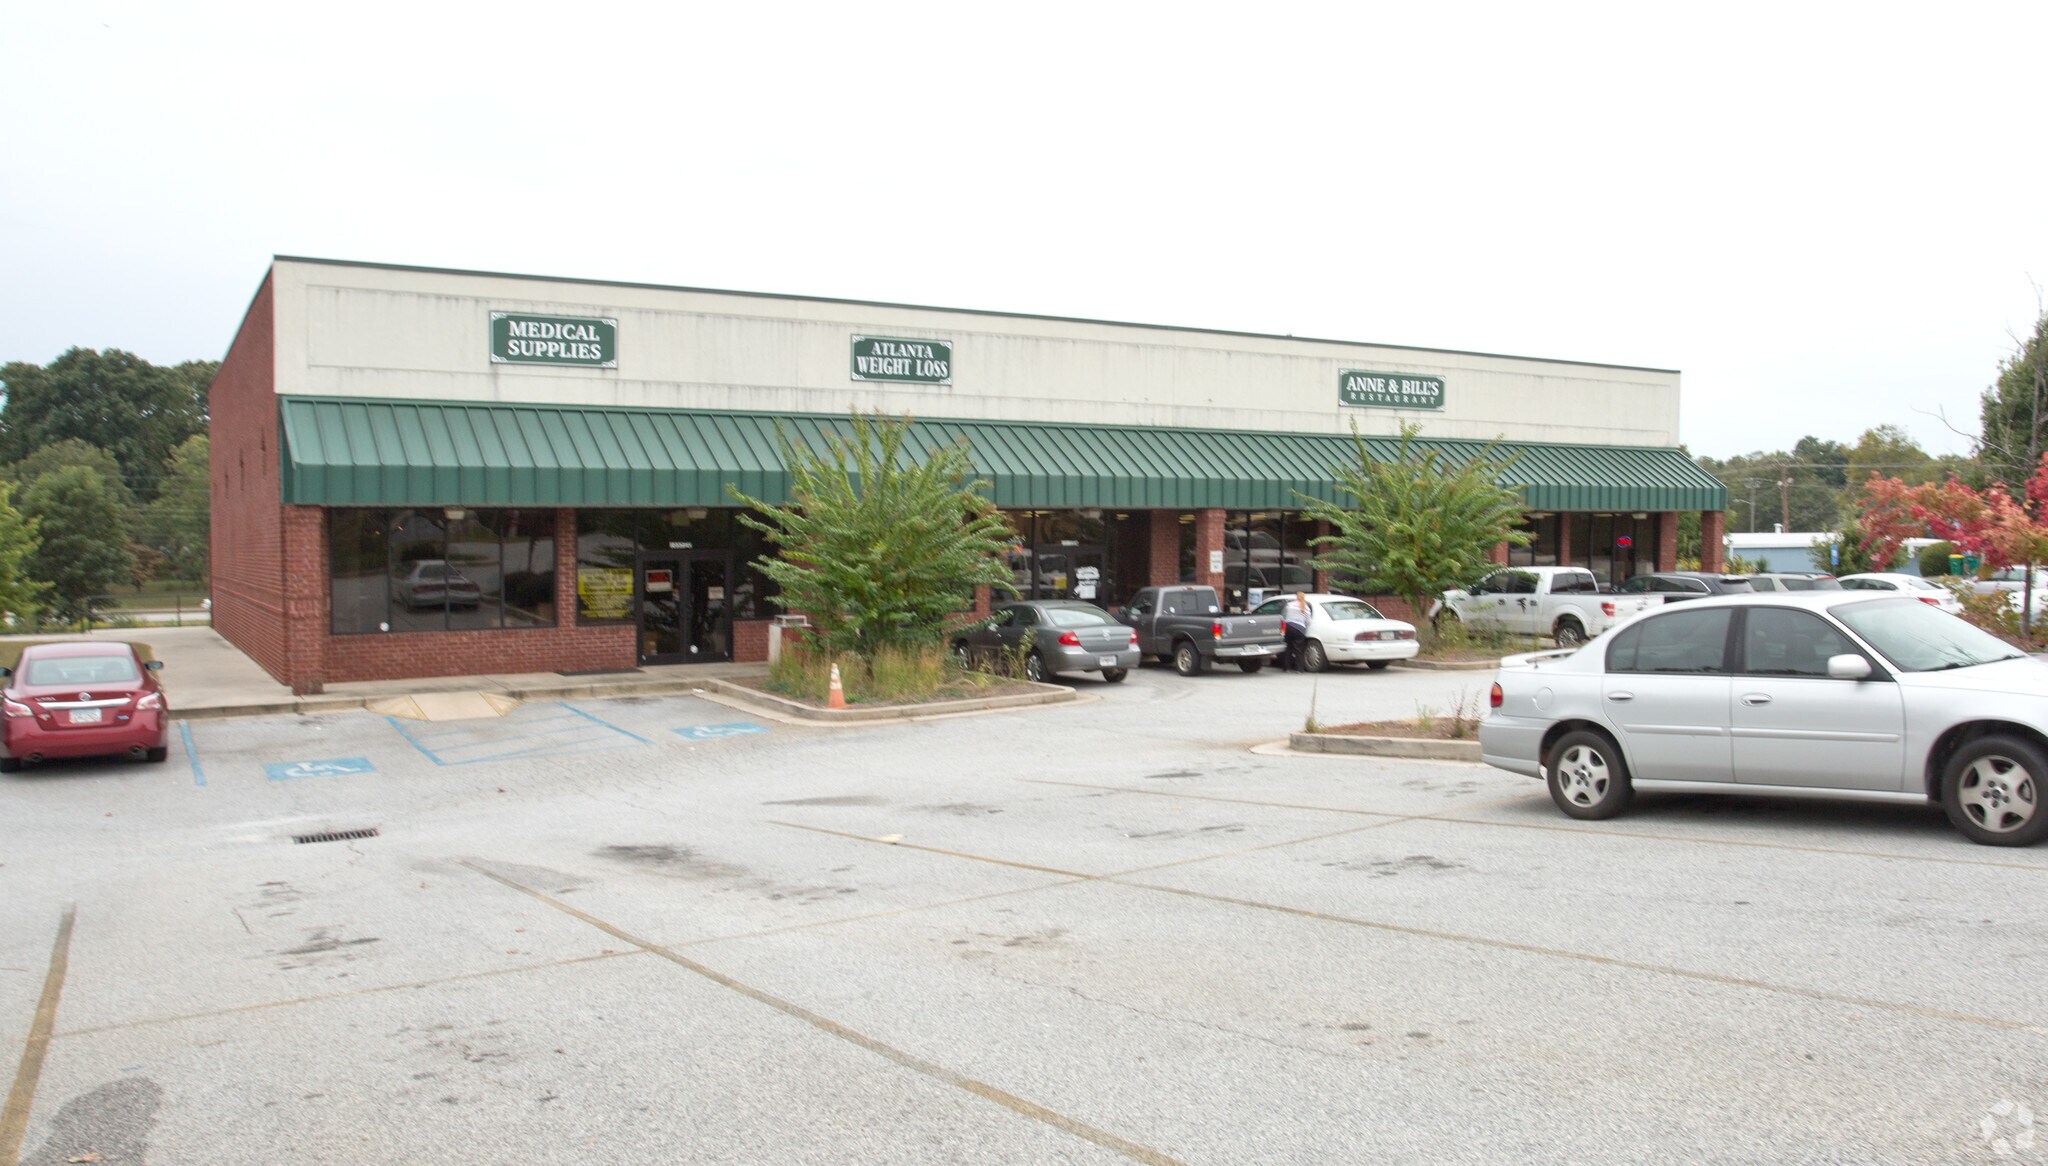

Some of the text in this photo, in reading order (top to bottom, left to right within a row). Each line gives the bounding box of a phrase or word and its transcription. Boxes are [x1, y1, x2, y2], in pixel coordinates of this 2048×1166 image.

[508, 320, 600, 341] MEDICAL
[507, 339, 601, 360] SUPPLIES
[871, 341, 934, 359] ATLANTA
[856, 356, 948, 378] WEIGHT LOSS
[1346, 376, 1440, 397] ANNE & BILL'S
[1350, 391, 1436, 405] RESTAURANT
